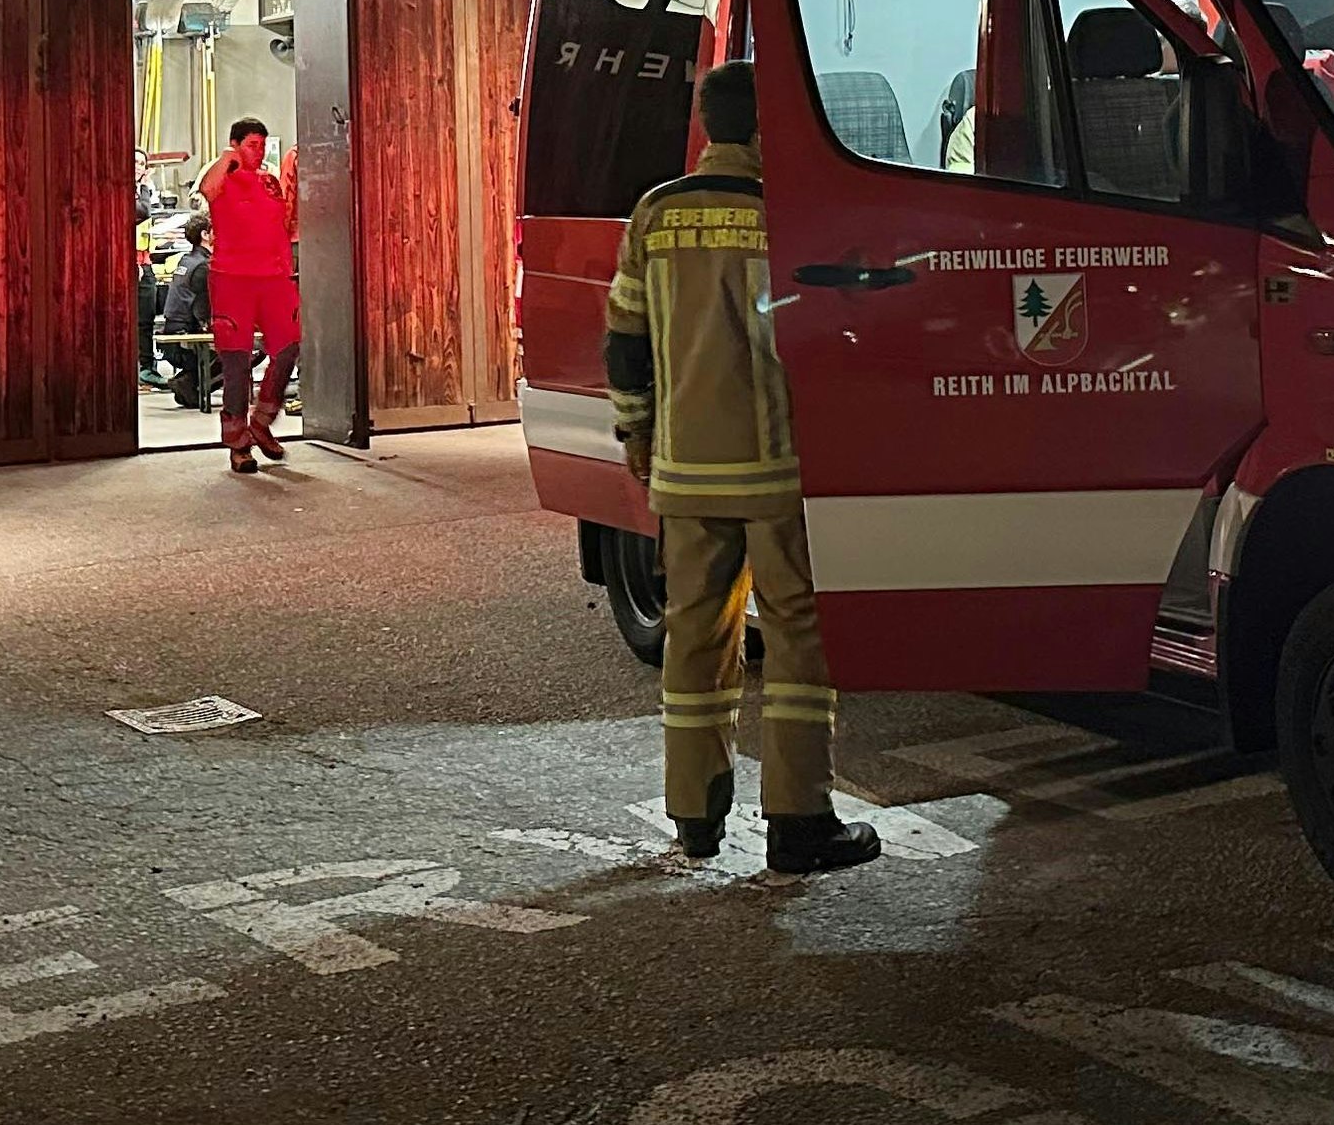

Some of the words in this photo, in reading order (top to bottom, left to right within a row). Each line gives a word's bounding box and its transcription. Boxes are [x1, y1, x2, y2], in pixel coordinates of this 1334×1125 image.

[663, 207, 760, 227] FEUERWEHR
[928, 248, 1046, 271] FREIWILLIGE
[1055, 246, 1169, 269] FEUERWEHR
[933, 375, 994, 396] REITH
[1004, 374, 1030, 395] IM
[1041, 370, 1175, 394] ALPBACHTAL
